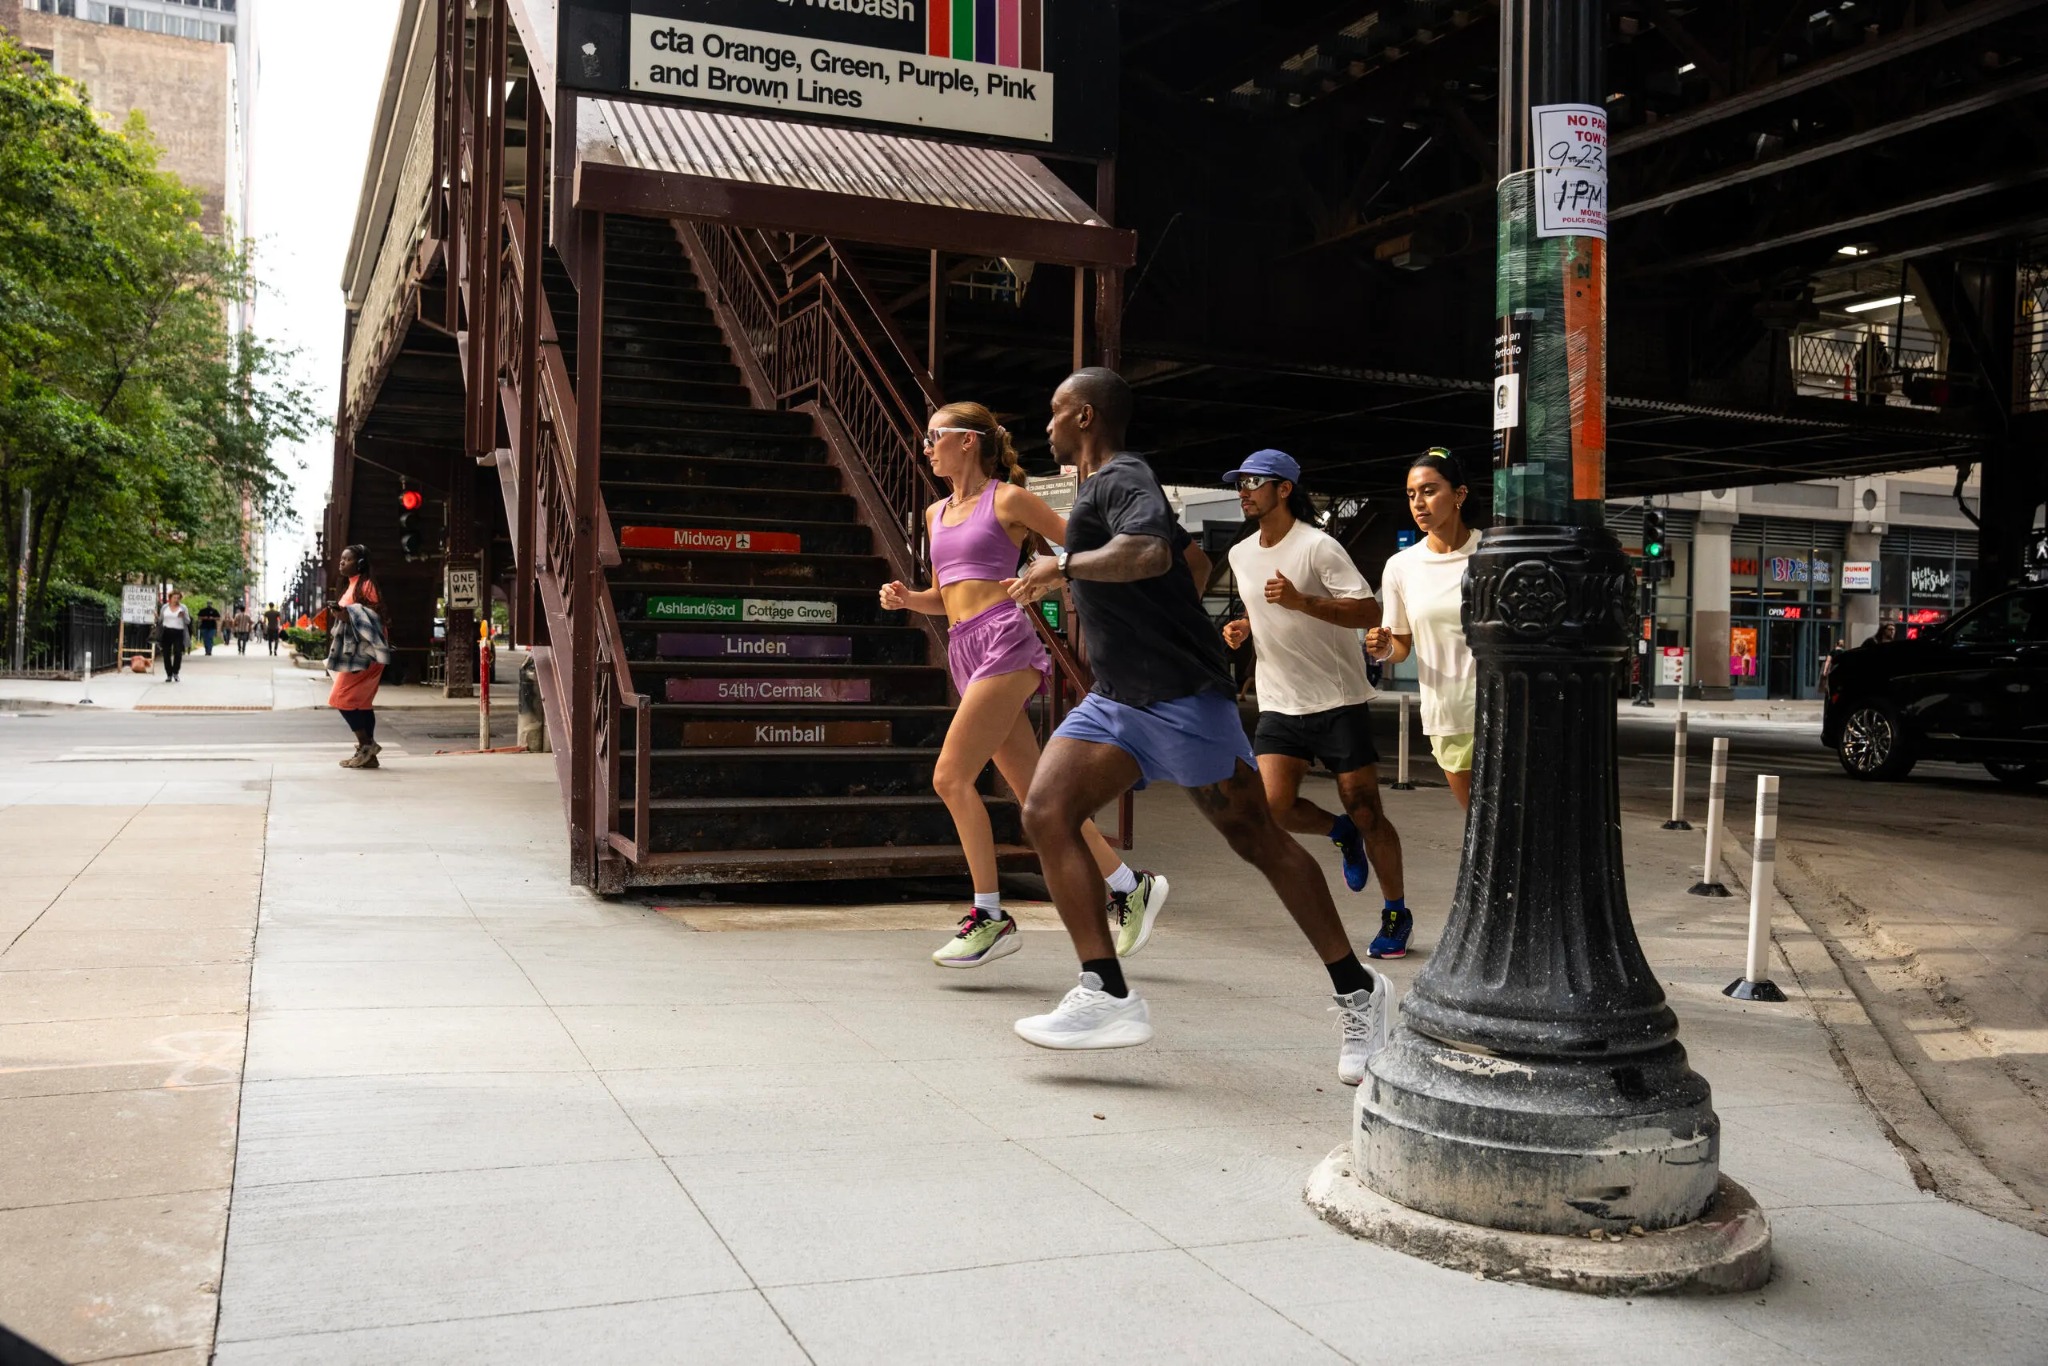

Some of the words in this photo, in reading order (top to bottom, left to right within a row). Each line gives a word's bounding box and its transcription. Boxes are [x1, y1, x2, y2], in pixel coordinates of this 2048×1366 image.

[650, 26, 694, 54] cta
[702, 33, 802, 74] Orange,
[810, 48, 890, 85] Green,
[899, 60, 979, 97] Purple,
[987, 72, 1036, 101] Pink
[650, 64, 698, 88] and
[708, 66, 788, 99] Brown
[797, 78, 862, 108] Lines
[1567, 114, 1588, 126] NO
[1575, 130, 1601, 144] TOW
[1580, 208, 1602, 219] MOVIE
[1510, 332, 1520, 341] an
[673, 530, 732, 550] Midway
[1771, 557, 1797, 582] BR
[452, 573, 474, 583] ONE
[452, 584, 475, 593] WAY
[656, 602, 736, 617] Ashland/63rd
[748, 604, 794, 619] Cottage
[797, 606, 832, 618] Grove
[727, 638, 787, 654] Linden
[718, 682, 822, 698] 54th/Cermak
[755, 725, 825, 743] Kimball
